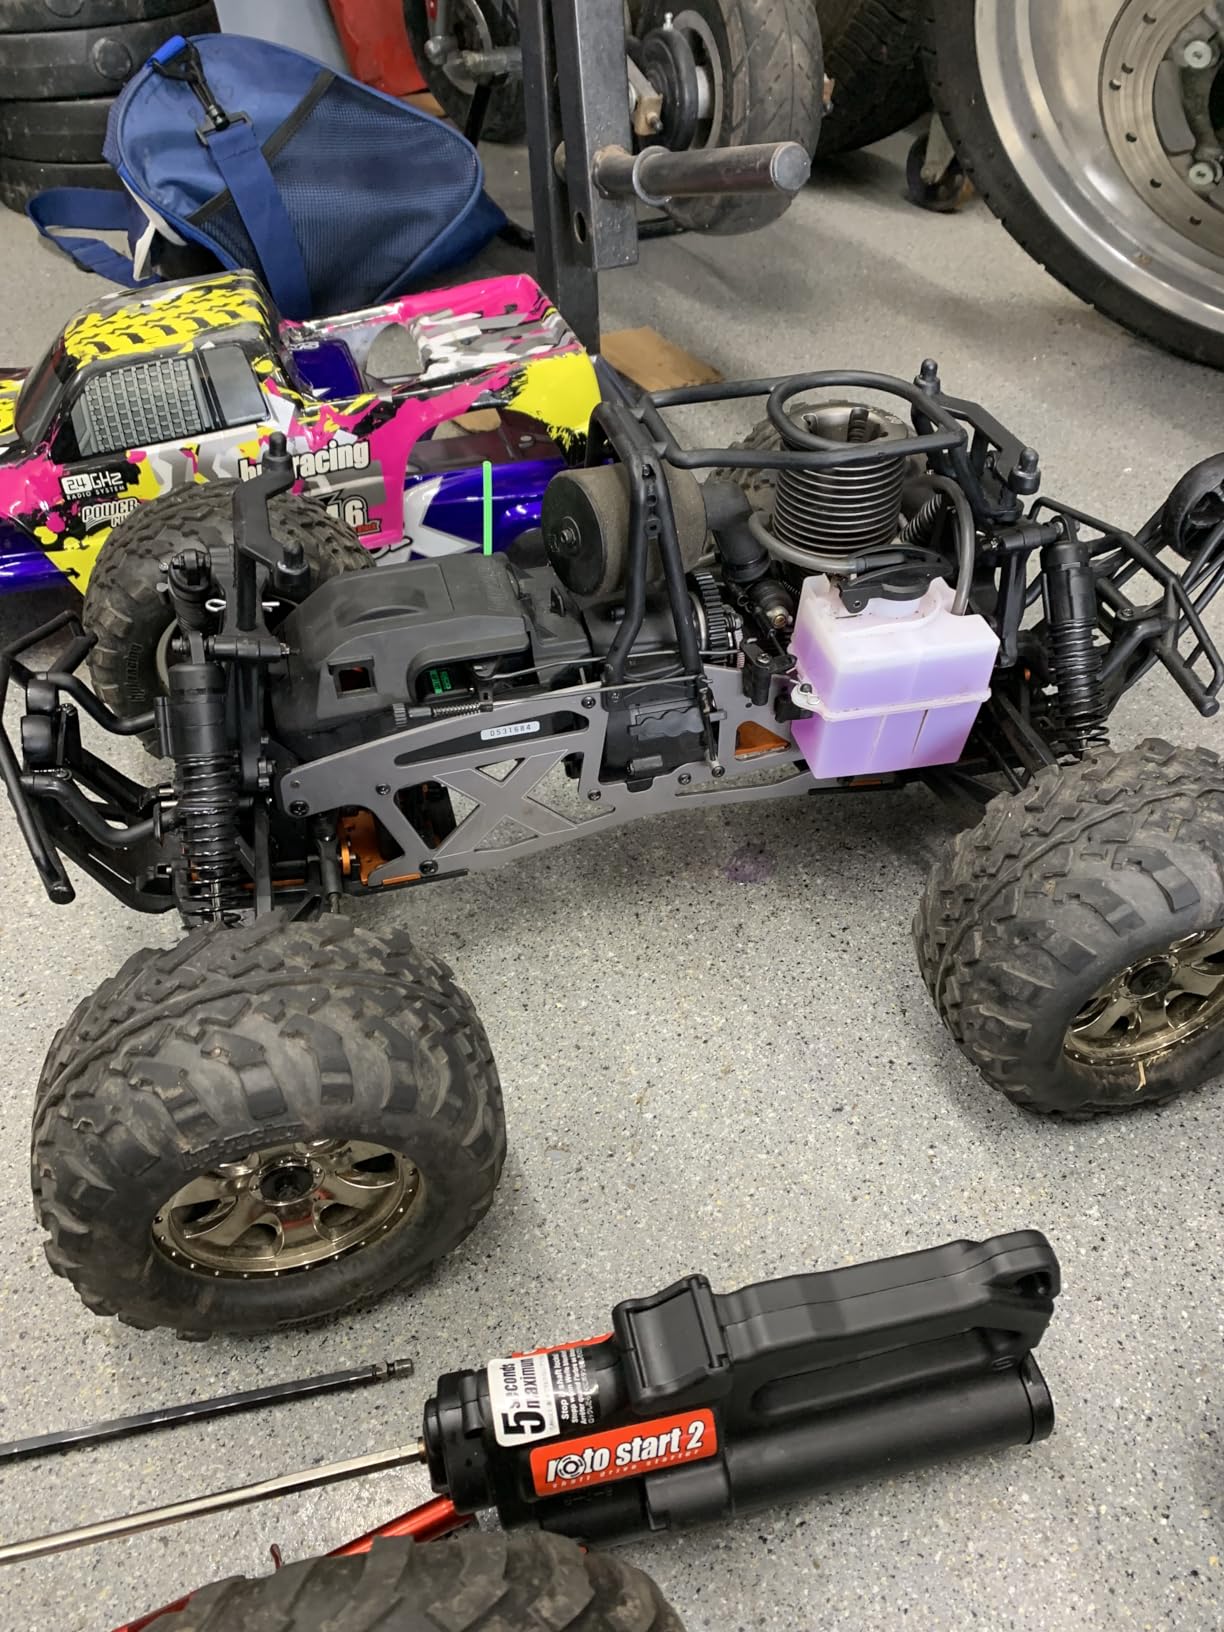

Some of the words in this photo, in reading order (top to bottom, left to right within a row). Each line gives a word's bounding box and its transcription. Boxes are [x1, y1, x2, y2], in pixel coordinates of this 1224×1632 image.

[293, 439, 369, 478] racing
[66, 490, 92, 500] RADIO
[95, 485, 126, 497] SYSTEM
[82, 498, 138, 522] POWER
[560, 1399, 570, 1420] Stop
[501, 1411, 546, 1435] 5
[546, 1447, 611, 1482] roto
[615, 1428, 682, 1466] start
[686, 1420, 705, 1450] 2
